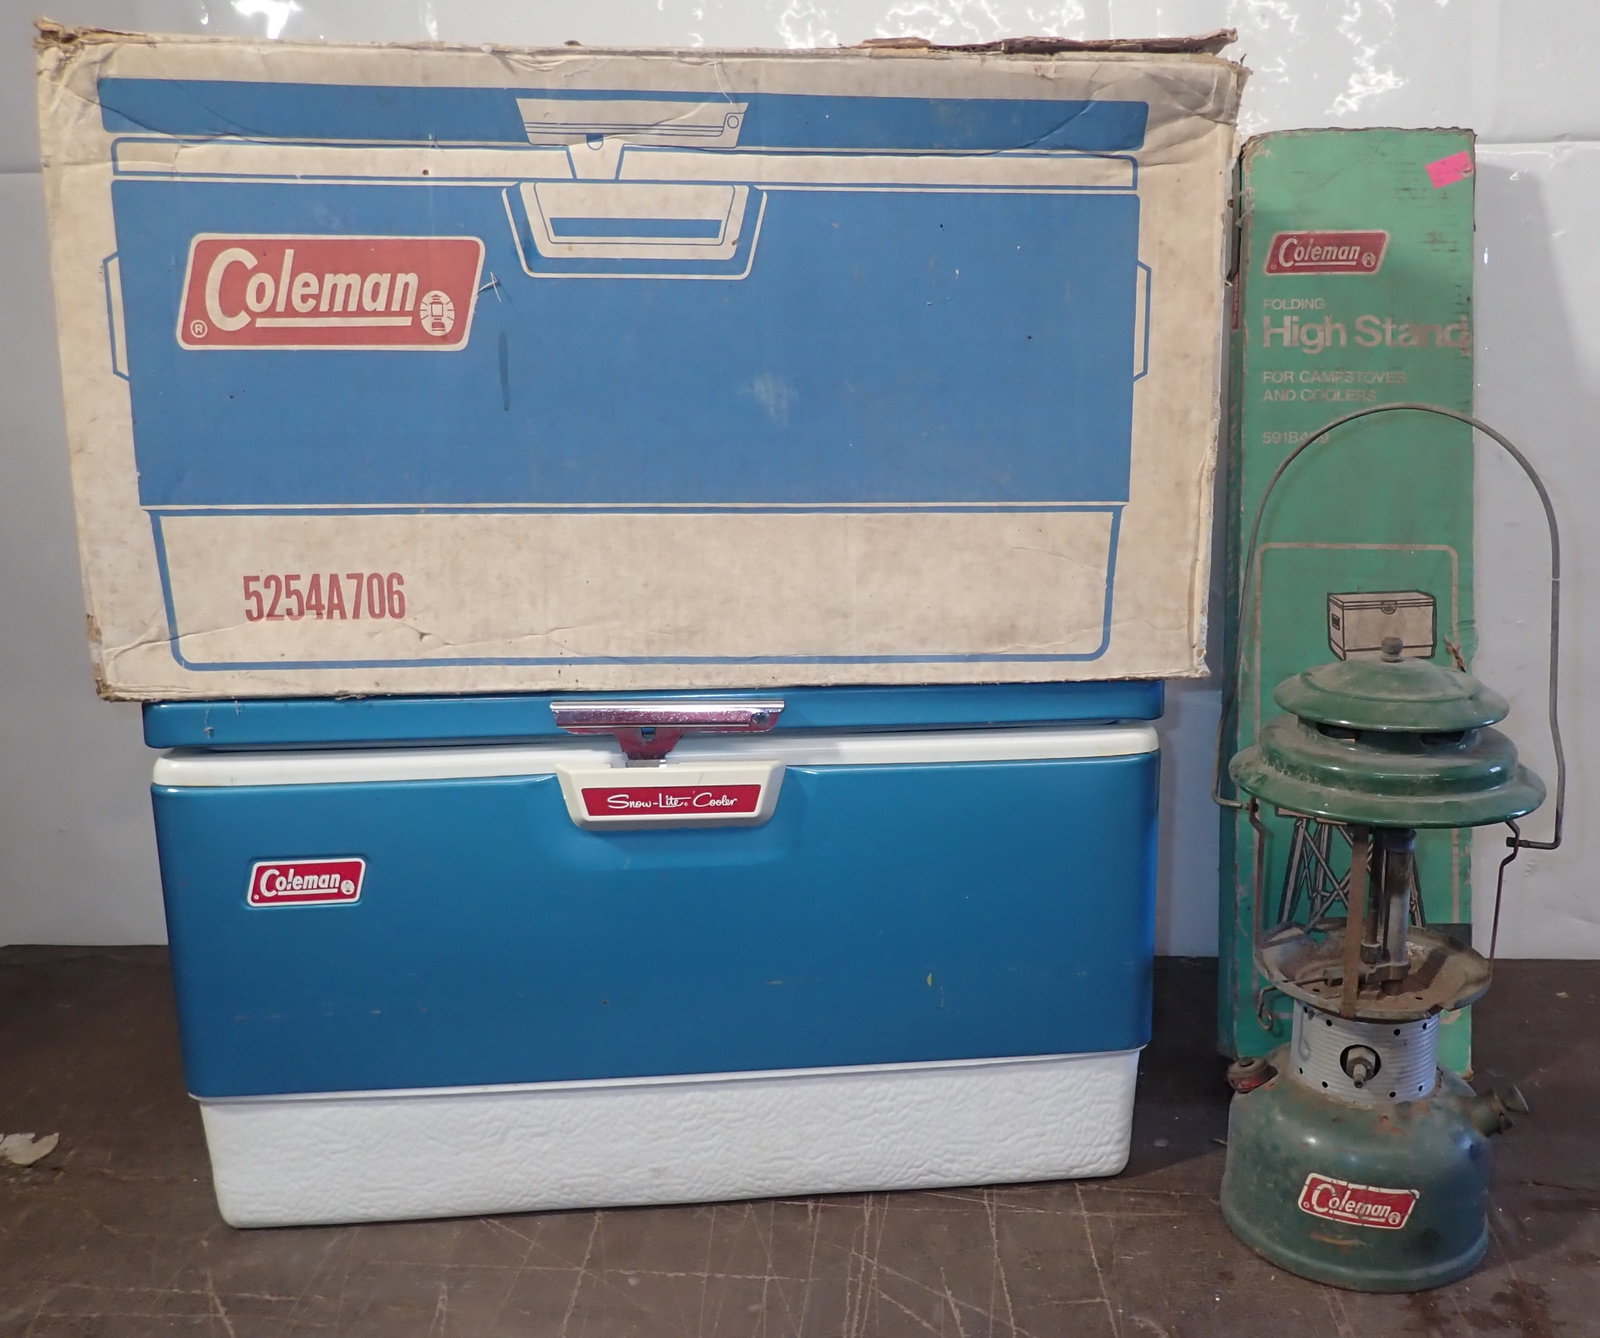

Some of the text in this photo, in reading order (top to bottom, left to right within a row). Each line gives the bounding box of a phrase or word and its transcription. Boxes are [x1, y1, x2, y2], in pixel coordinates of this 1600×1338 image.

[1279, 238, 1360, 267] Coleman
[205, 247, 419, 331] Coleman
[1264, 299, 1325, 310] FOLDING
[1263, 315, 1471, 354] High Stand
[1263, 371, 1295, 383] FOR
[1263, 389, 1297, 401] AND
[243, 572, 406, 622] 5254A706
[693, 792, 737, 807] Cooler
[260, 868, 340, 897] Coleman
[1312, 1183, 1391, 1217] Coleman
